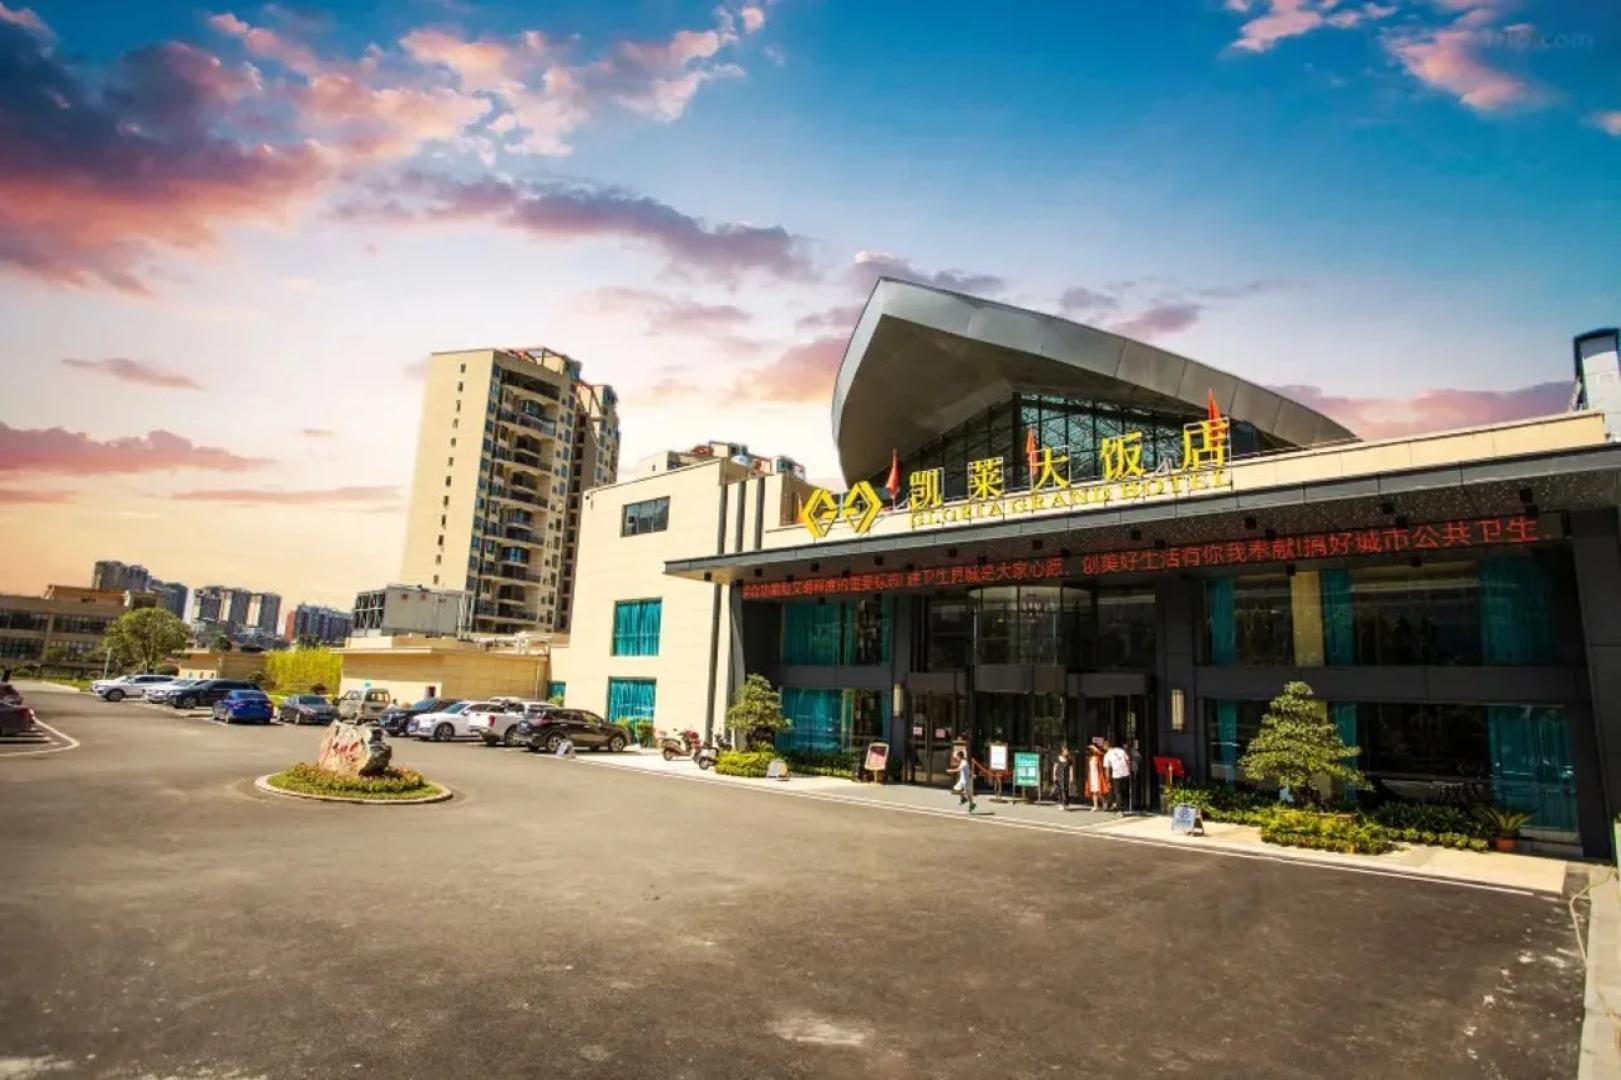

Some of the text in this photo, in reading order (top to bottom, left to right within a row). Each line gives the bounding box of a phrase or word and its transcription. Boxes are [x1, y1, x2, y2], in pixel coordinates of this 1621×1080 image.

[909, 420, 1227, 509] 凯莱大饭店
[911, 469, 1229, 527] GLORIA GRAND HOTEL
